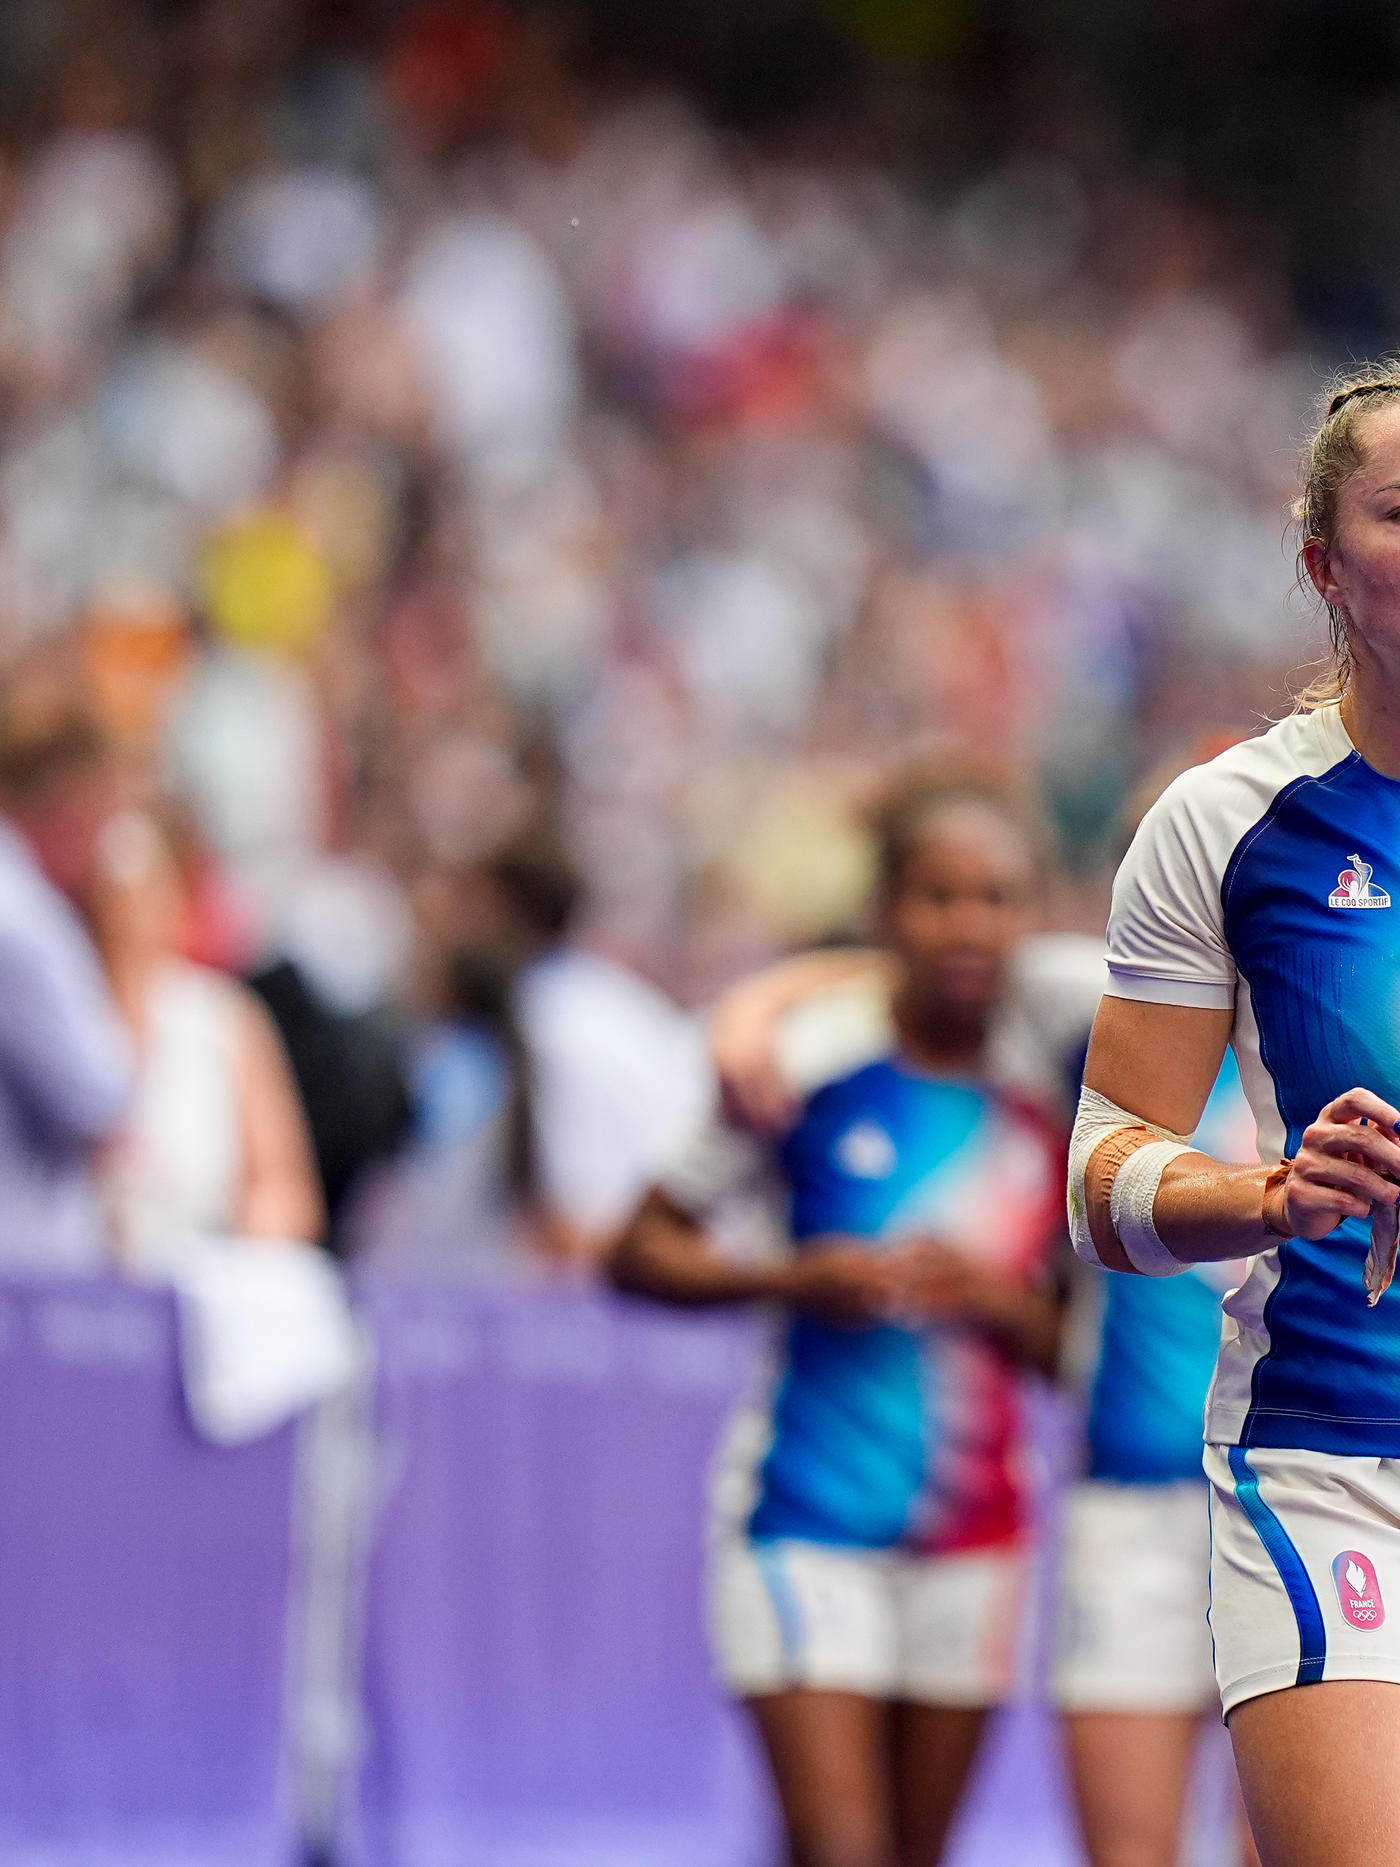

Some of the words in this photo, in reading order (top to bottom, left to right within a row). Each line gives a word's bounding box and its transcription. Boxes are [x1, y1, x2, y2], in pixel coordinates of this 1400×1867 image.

[1330, 898, 1339, 906] LE
[1358, 897, 1388, 907] SPORTIF
[1349, 1598, 1376, 1608] FRANCE
